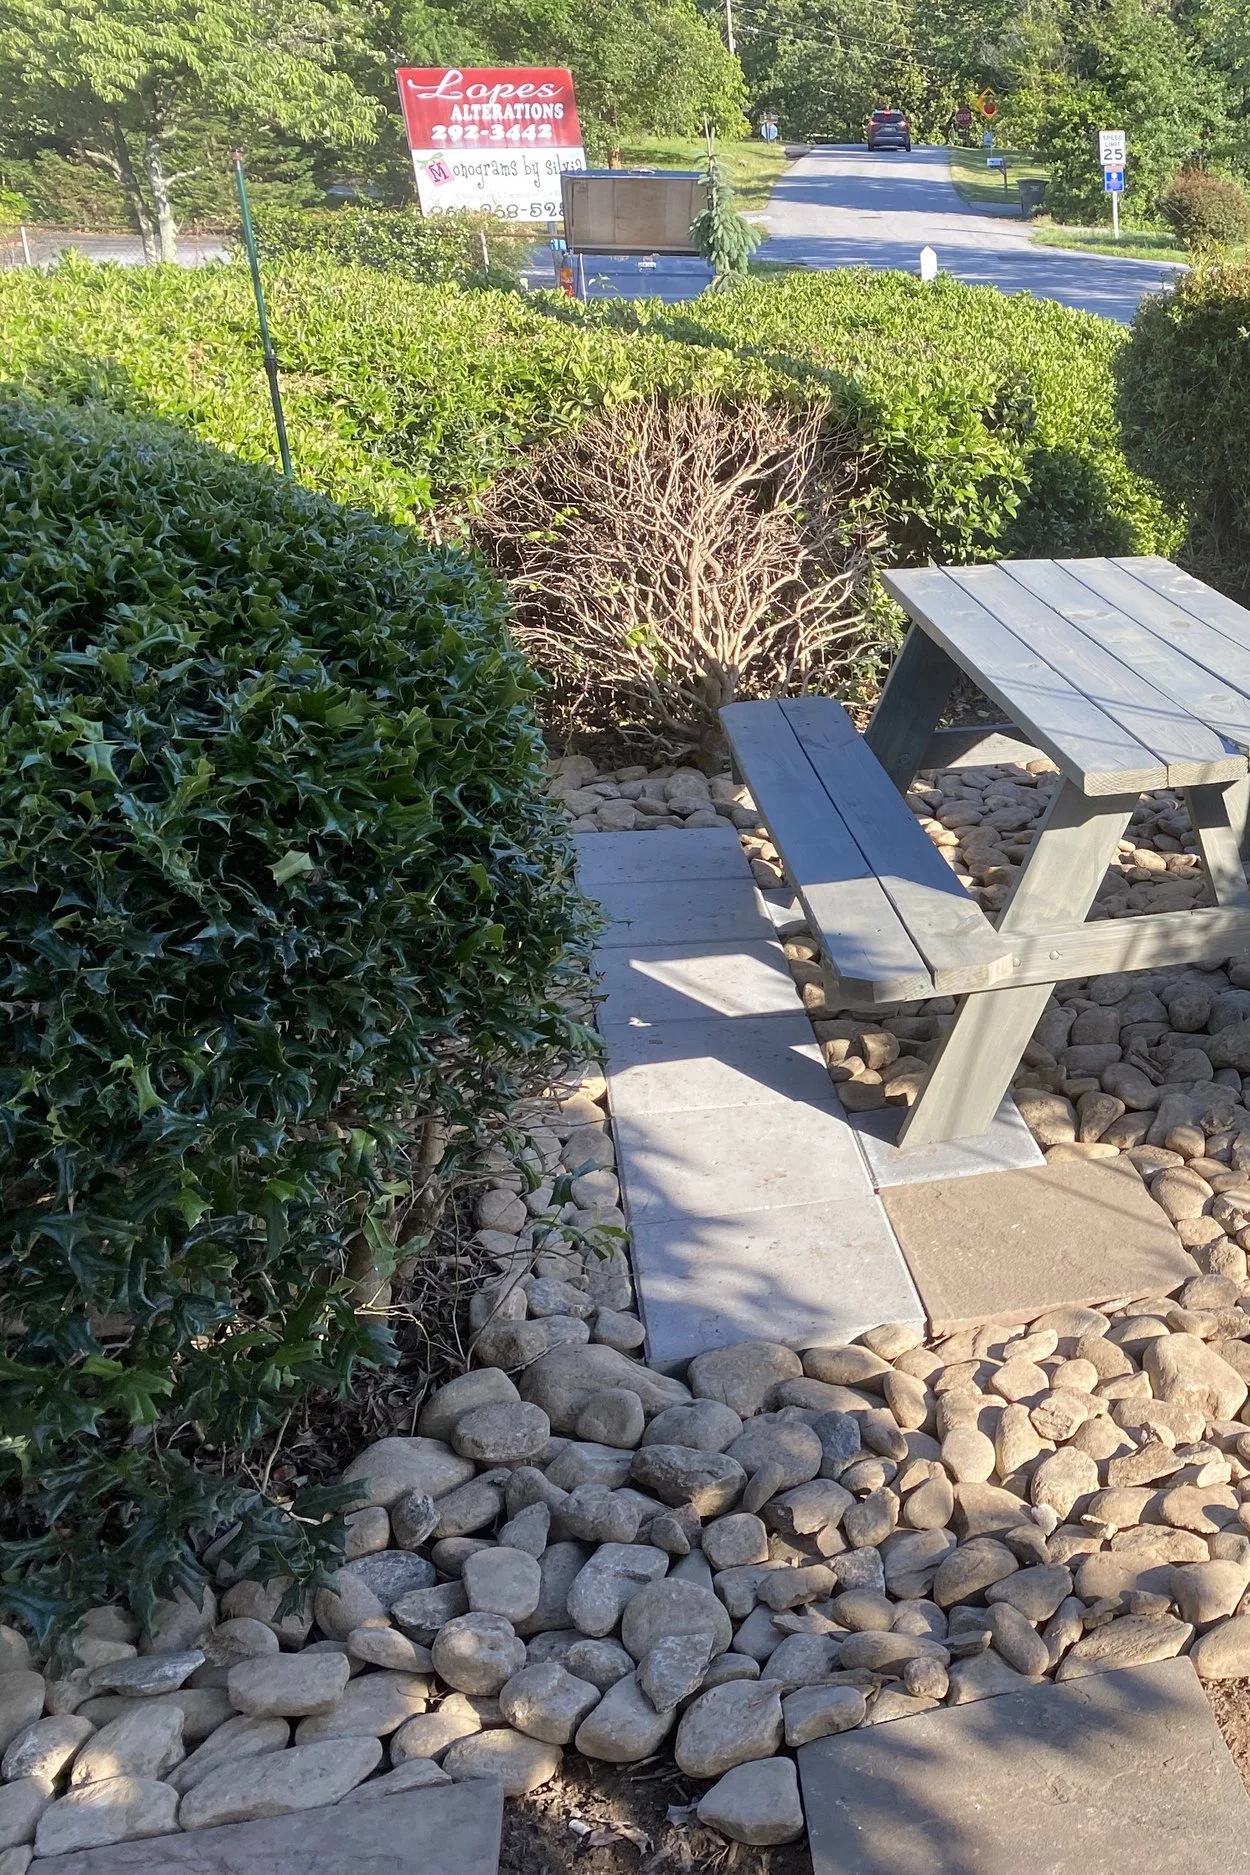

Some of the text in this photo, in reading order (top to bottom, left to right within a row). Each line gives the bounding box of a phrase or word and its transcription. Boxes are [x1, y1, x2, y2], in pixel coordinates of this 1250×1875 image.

[407, 69, 564, 104] Lopes
[450, 103, 564, 121] ALTERATIONS
[431, 123, 553, 141] 292-3442
[1104, 148, 1123, 160] 25
[522, 155, 541, 188] by
